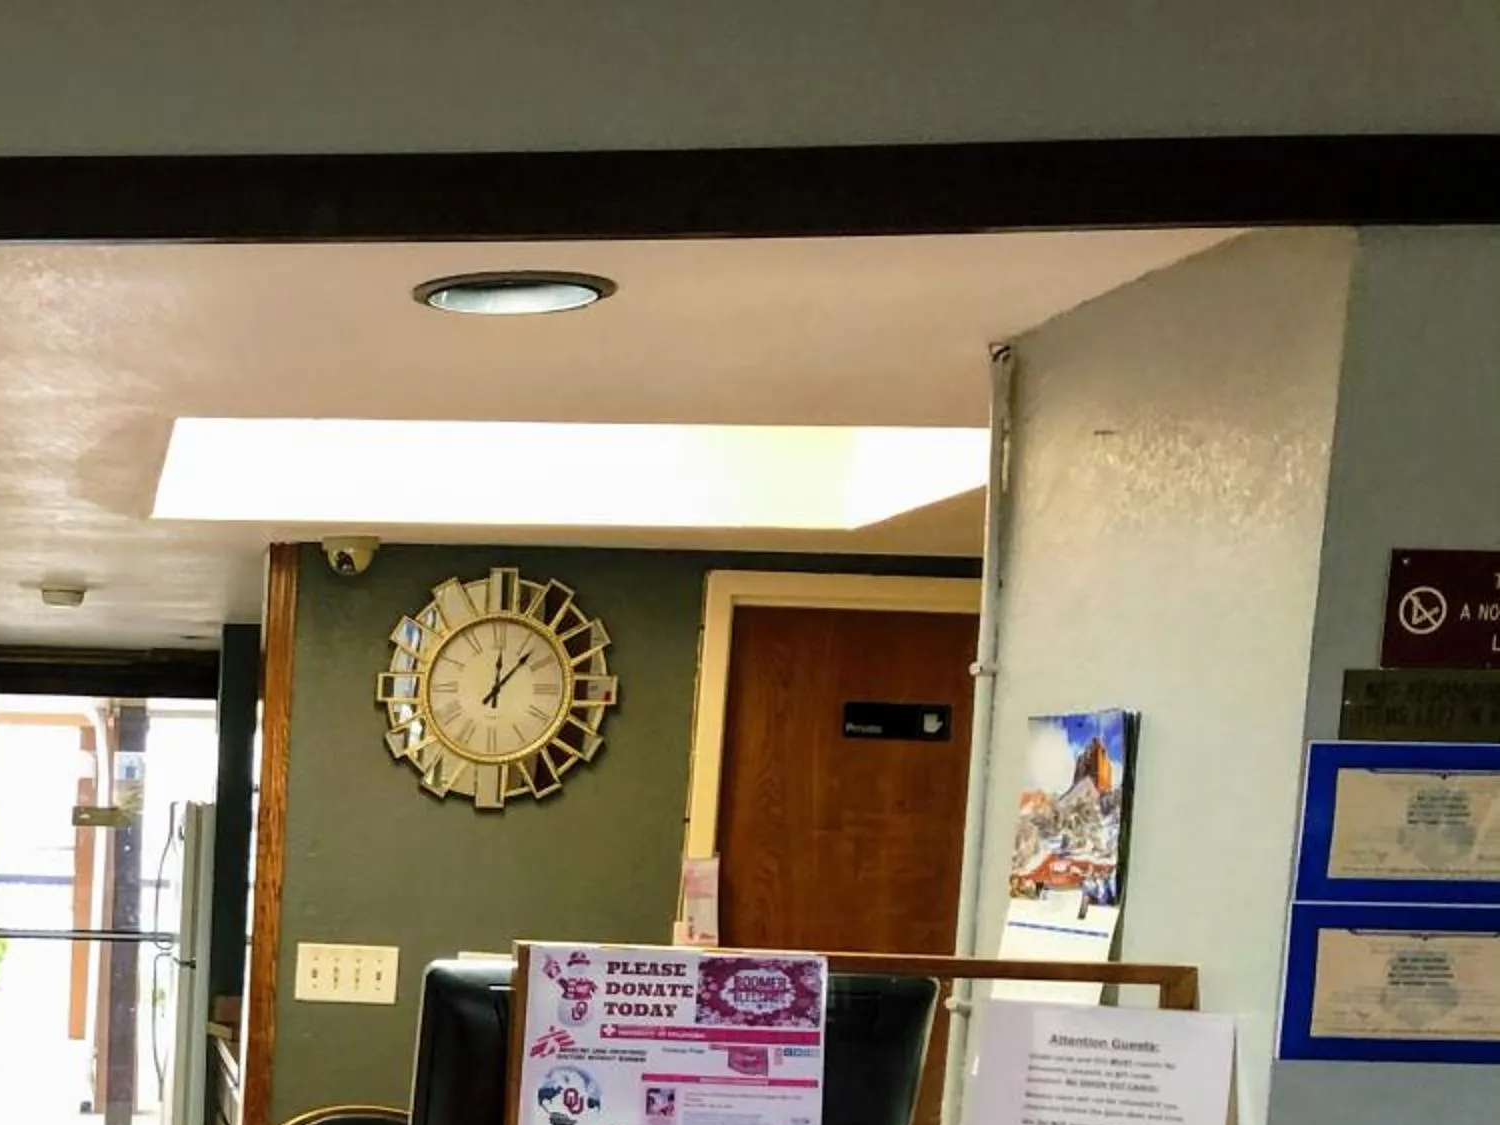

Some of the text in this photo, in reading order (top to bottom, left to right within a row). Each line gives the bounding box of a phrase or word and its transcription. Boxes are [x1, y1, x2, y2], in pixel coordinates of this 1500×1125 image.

[1460, 602, 1471, 621] A
[607, 961, 687, 977] PLEASE
[605, 982, 695, 998] DONATE
[604, 1002, 678, 1018] TODAY
[1049, 1034, 1108, 1050] Attention
